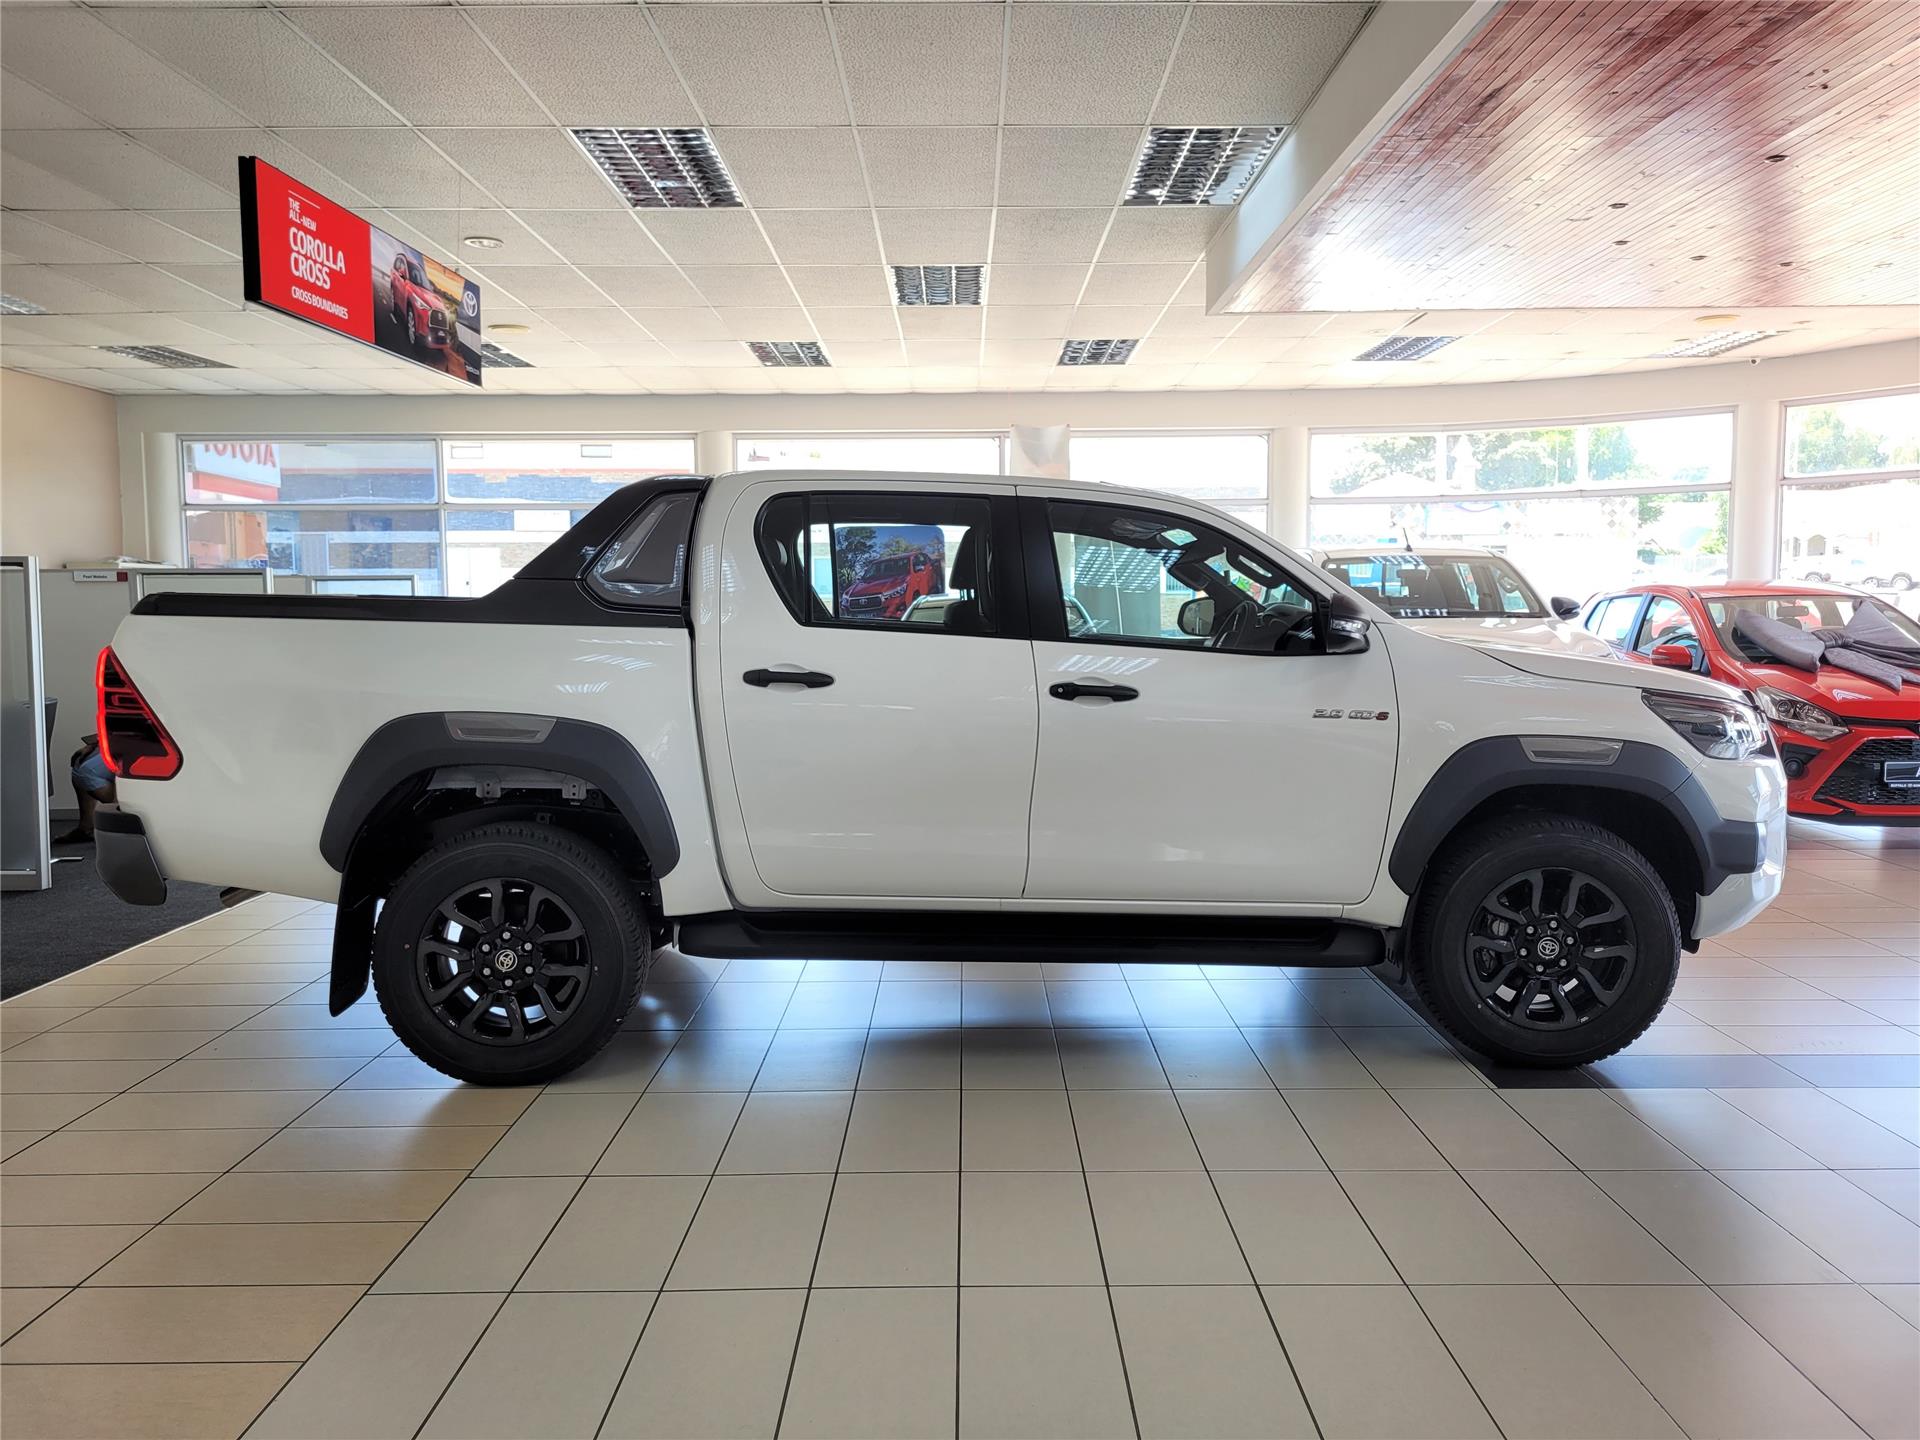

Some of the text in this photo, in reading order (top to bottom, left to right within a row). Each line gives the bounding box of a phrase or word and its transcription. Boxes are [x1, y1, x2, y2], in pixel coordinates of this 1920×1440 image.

[288, 197, 301, 213] THE
[289, 208, 317, 232] ALL-NEW
[290, 226, 346, 274] COROLLA
[291, 252, 331, 290] CROSS
[291, 286, 349, 320] CROSS BOUNDARIES
